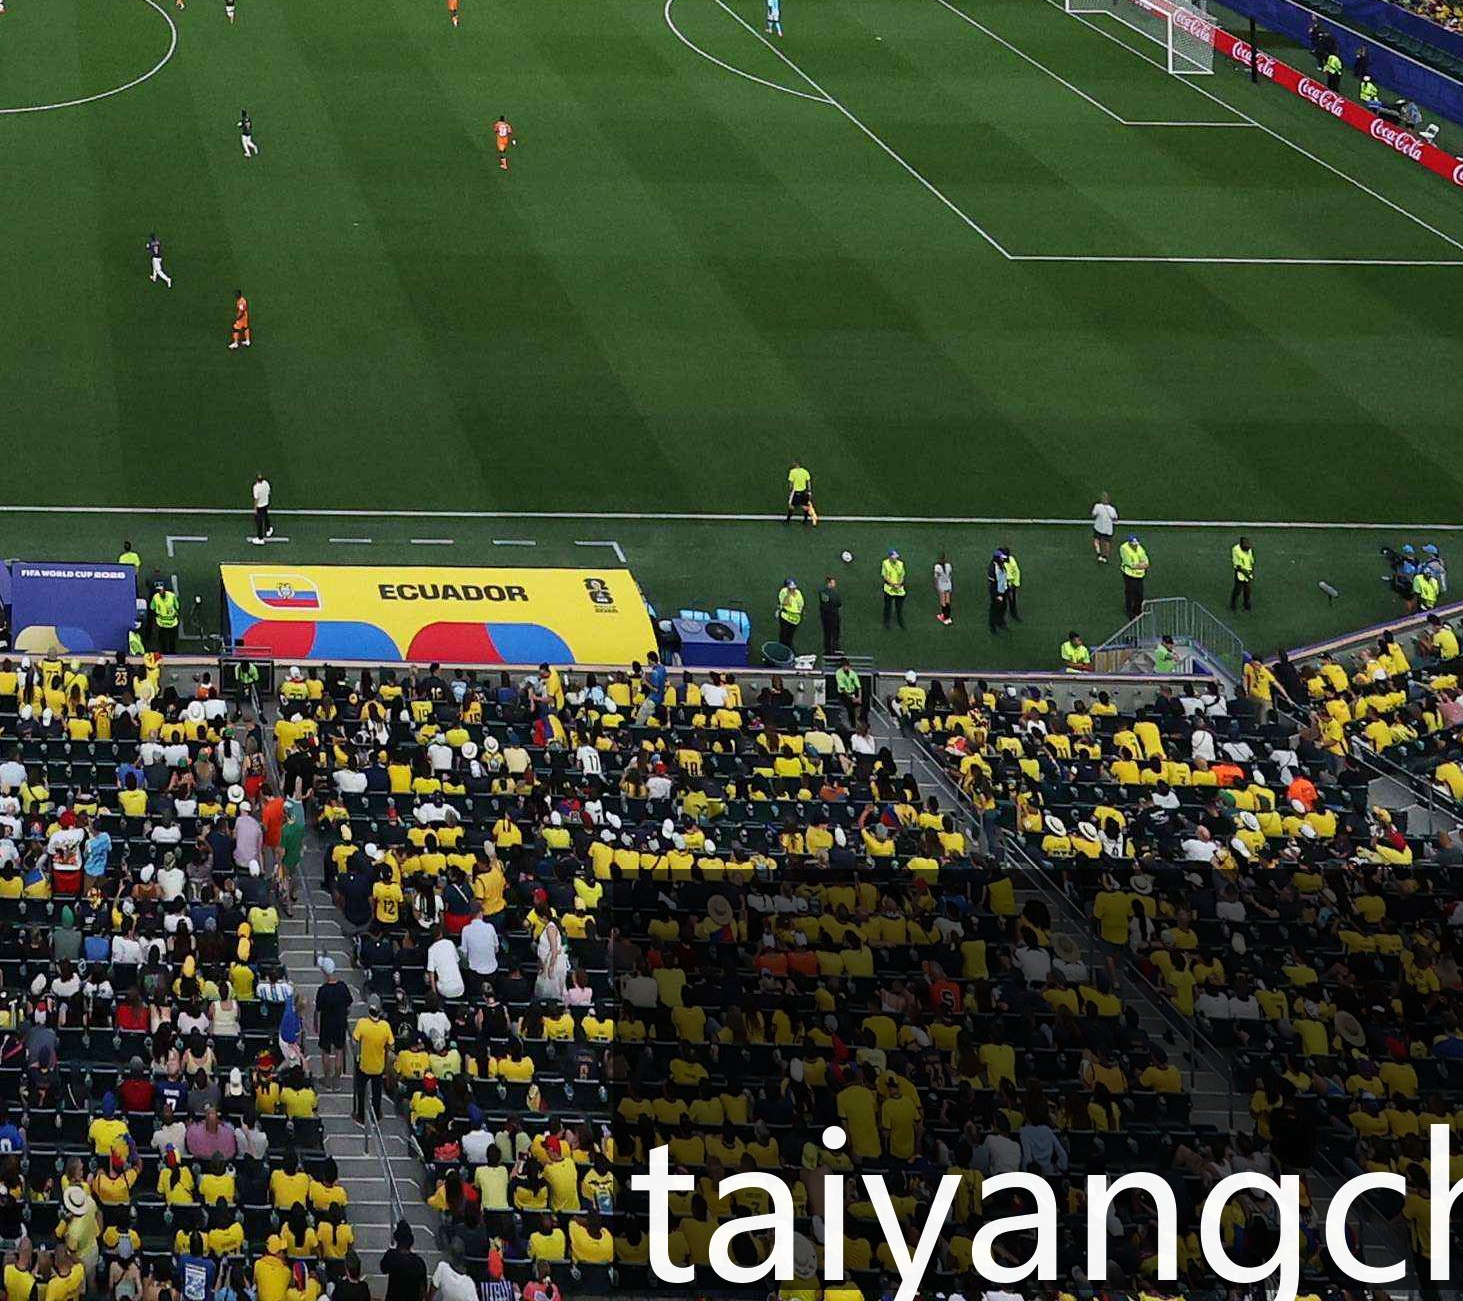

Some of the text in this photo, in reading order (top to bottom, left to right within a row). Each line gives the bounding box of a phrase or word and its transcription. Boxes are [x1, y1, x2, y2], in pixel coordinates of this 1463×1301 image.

[21, 569, 40, 577] FIFA
[41, 570, 73, 578] WORLD
[378, 584, 529, 602] ECUADOR
